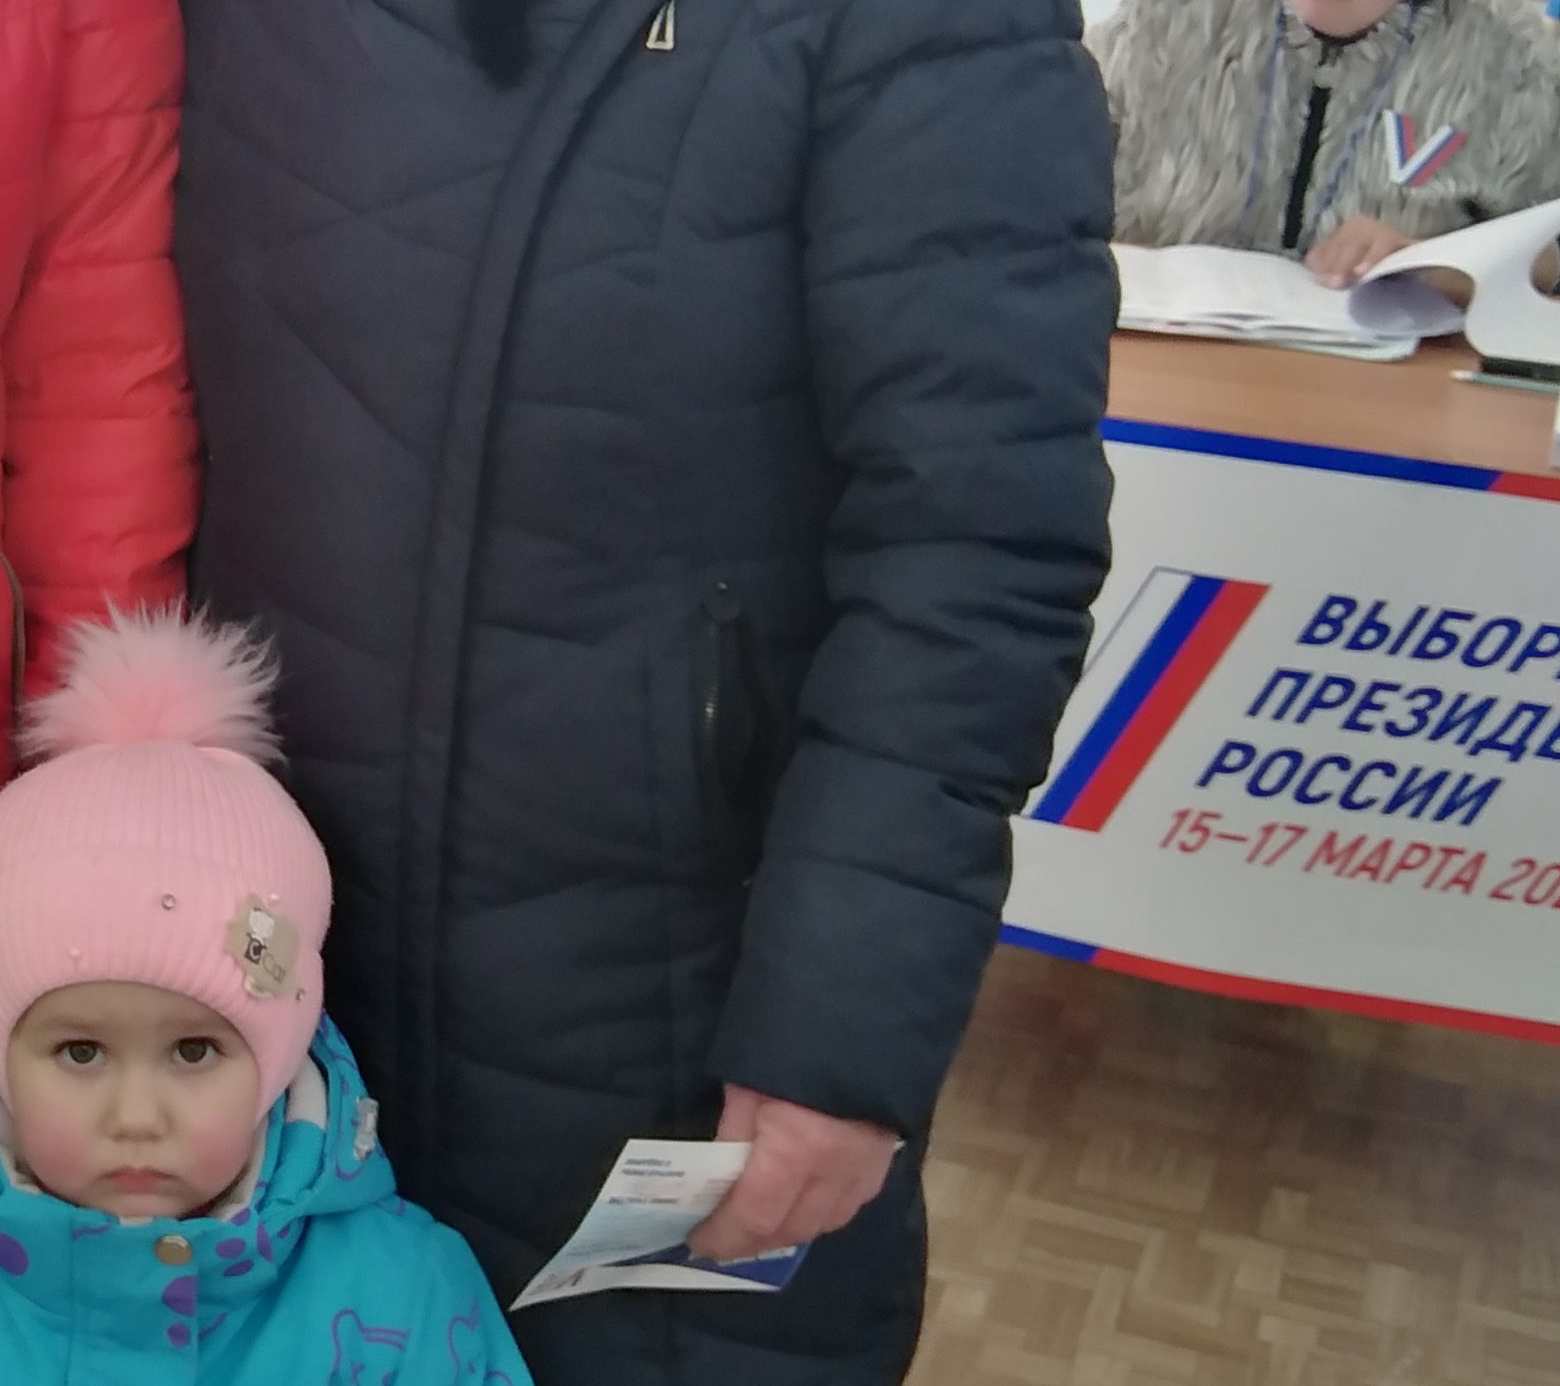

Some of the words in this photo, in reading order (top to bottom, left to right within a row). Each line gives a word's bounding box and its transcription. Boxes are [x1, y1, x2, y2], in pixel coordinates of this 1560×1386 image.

[1296, 593, 1560, 681] ВЫБОР
[1194, 739, 1504, 827] РОССИИ
[1302, 829, 1489, 897] МАРТА
[1488, 857, 1560, 910] 20
